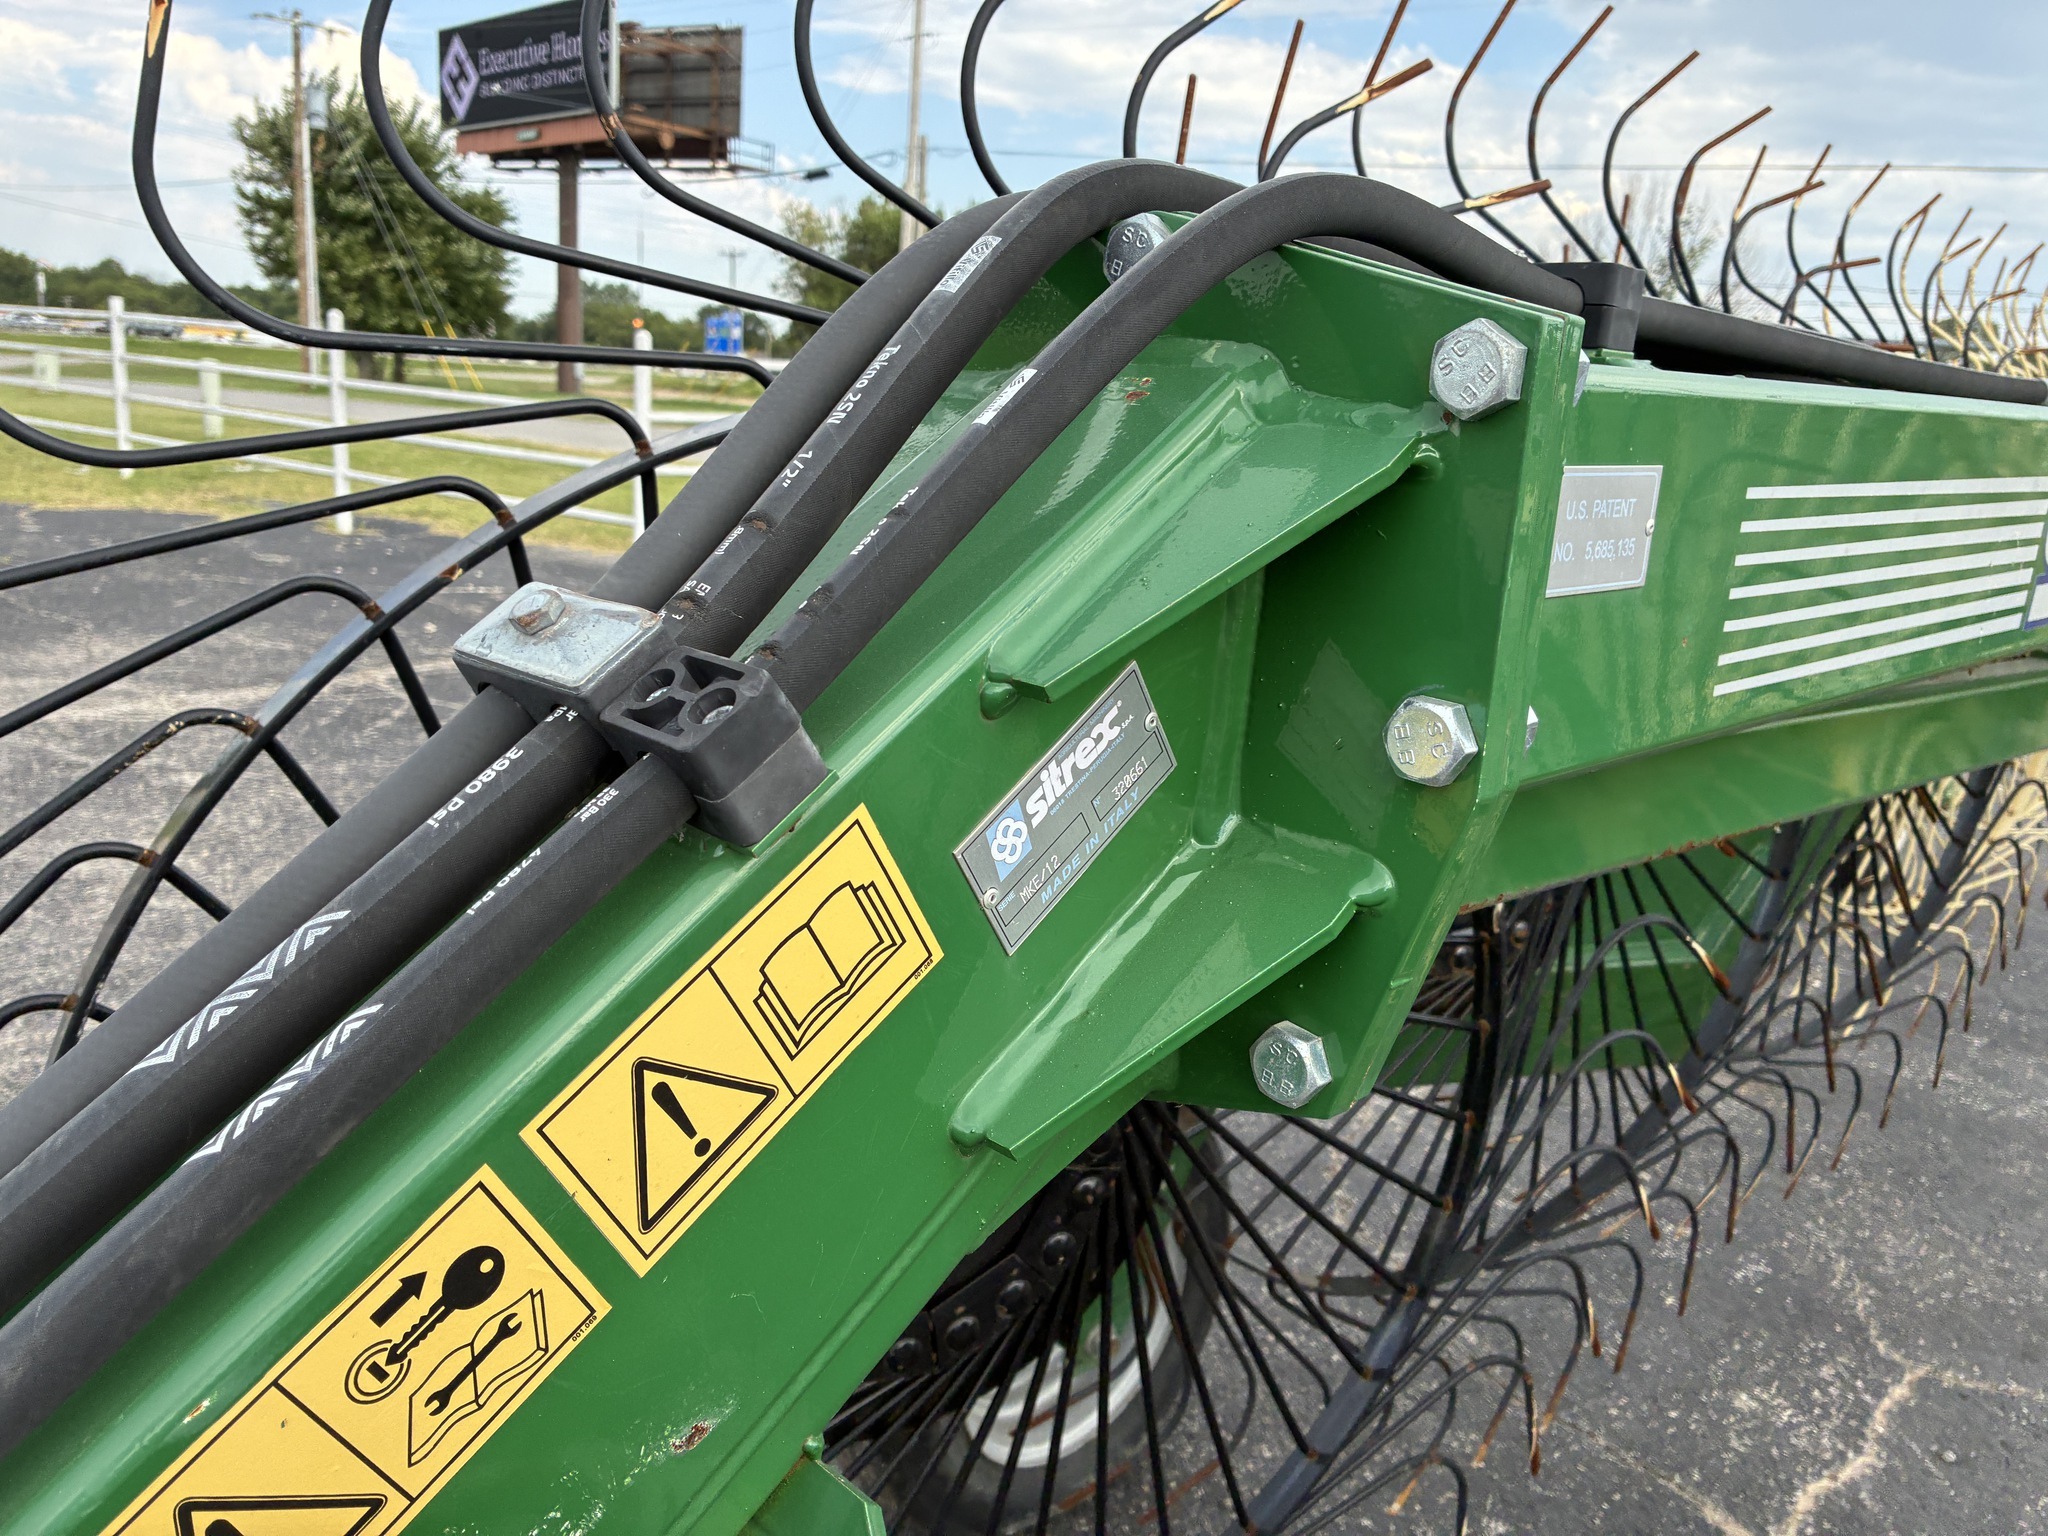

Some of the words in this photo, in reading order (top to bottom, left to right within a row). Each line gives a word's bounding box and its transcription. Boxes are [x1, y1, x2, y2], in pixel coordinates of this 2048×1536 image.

[478, 36, 550, 76] Executive
[855, 344, 901, 389] Tekno
[827, 393, 861, 424] 2SN
[878, 486, 918, 526] Teko
[1566, 500, 1588, 520] U.S.
[1592, 498, 1637, 518] PATENT
[1554, 542, 1575, 562] NO.
[465, 746, 524, 794] 3980
[1025, 704, 1119, 829] sitrex
[1111, 756, 1149, 801] 320661
[426, 797, 465, 828] Psi
[580, 805, 599, 822] Bar
[597, 788, 619, 806] 330
[1041, 853, 1081, 904] MADE
[1085, 832, 1100, 854] IN
[1104, 787, 1140, 834] ITALY
[1019, 855, 1061, 904] MKE/12
[998, 890, 1016, 912] SERIE
